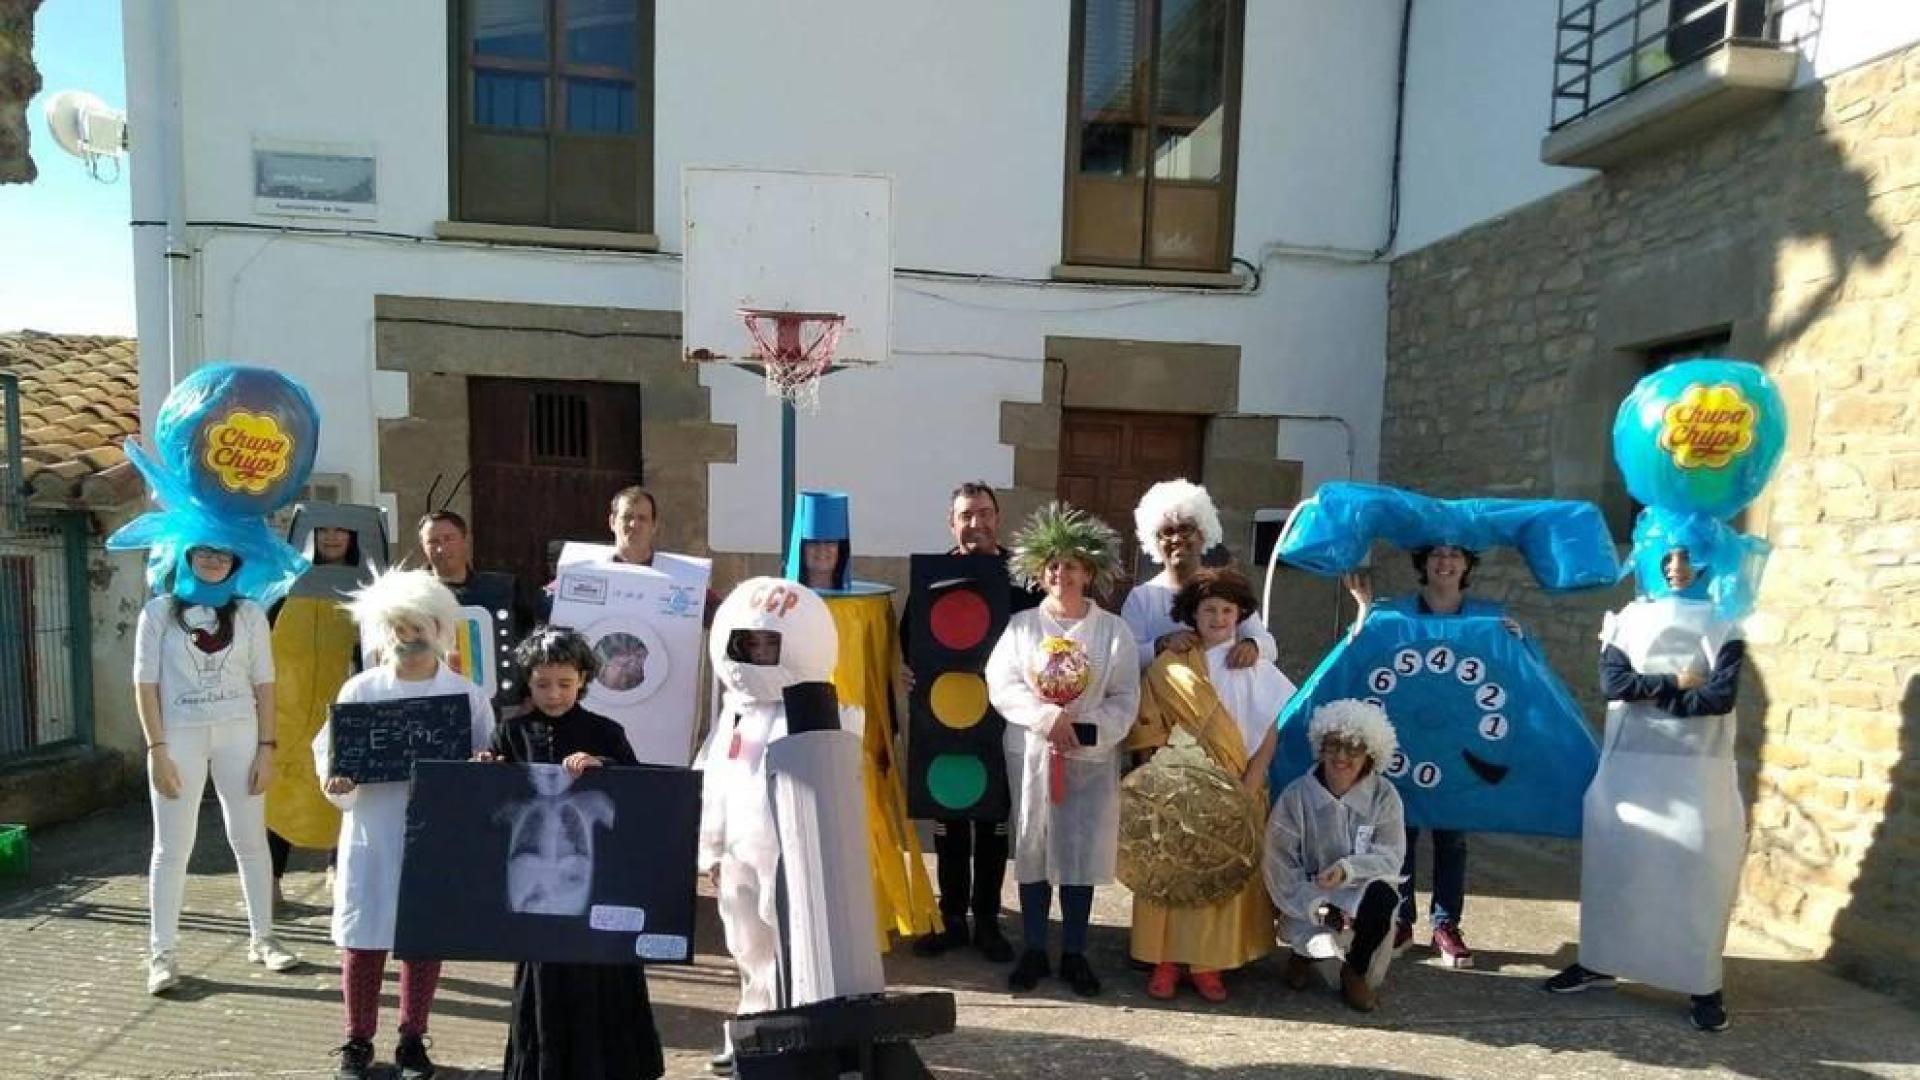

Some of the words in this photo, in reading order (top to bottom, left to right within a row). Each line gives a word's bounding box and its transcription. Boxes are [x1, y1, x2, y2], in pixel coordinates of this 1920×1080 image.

[1676, 404, 1747, 427] Chupa
[220, 428, 283, 453] Chupa
[1669, 424, 1739, 454] Chups
[214, 447, 278, 477] Chups
[1398, 654, 1415, 673] 5
[1432, 650, 1447, 670] 4
[1375, 672, 1390, 690] 6
[1462, 661, 1478, 681] 3
[1481, 686, 1498, 707] 2
[1486, 717, 1500, 737] 1
[1420, 764, 1435, 783] 0
